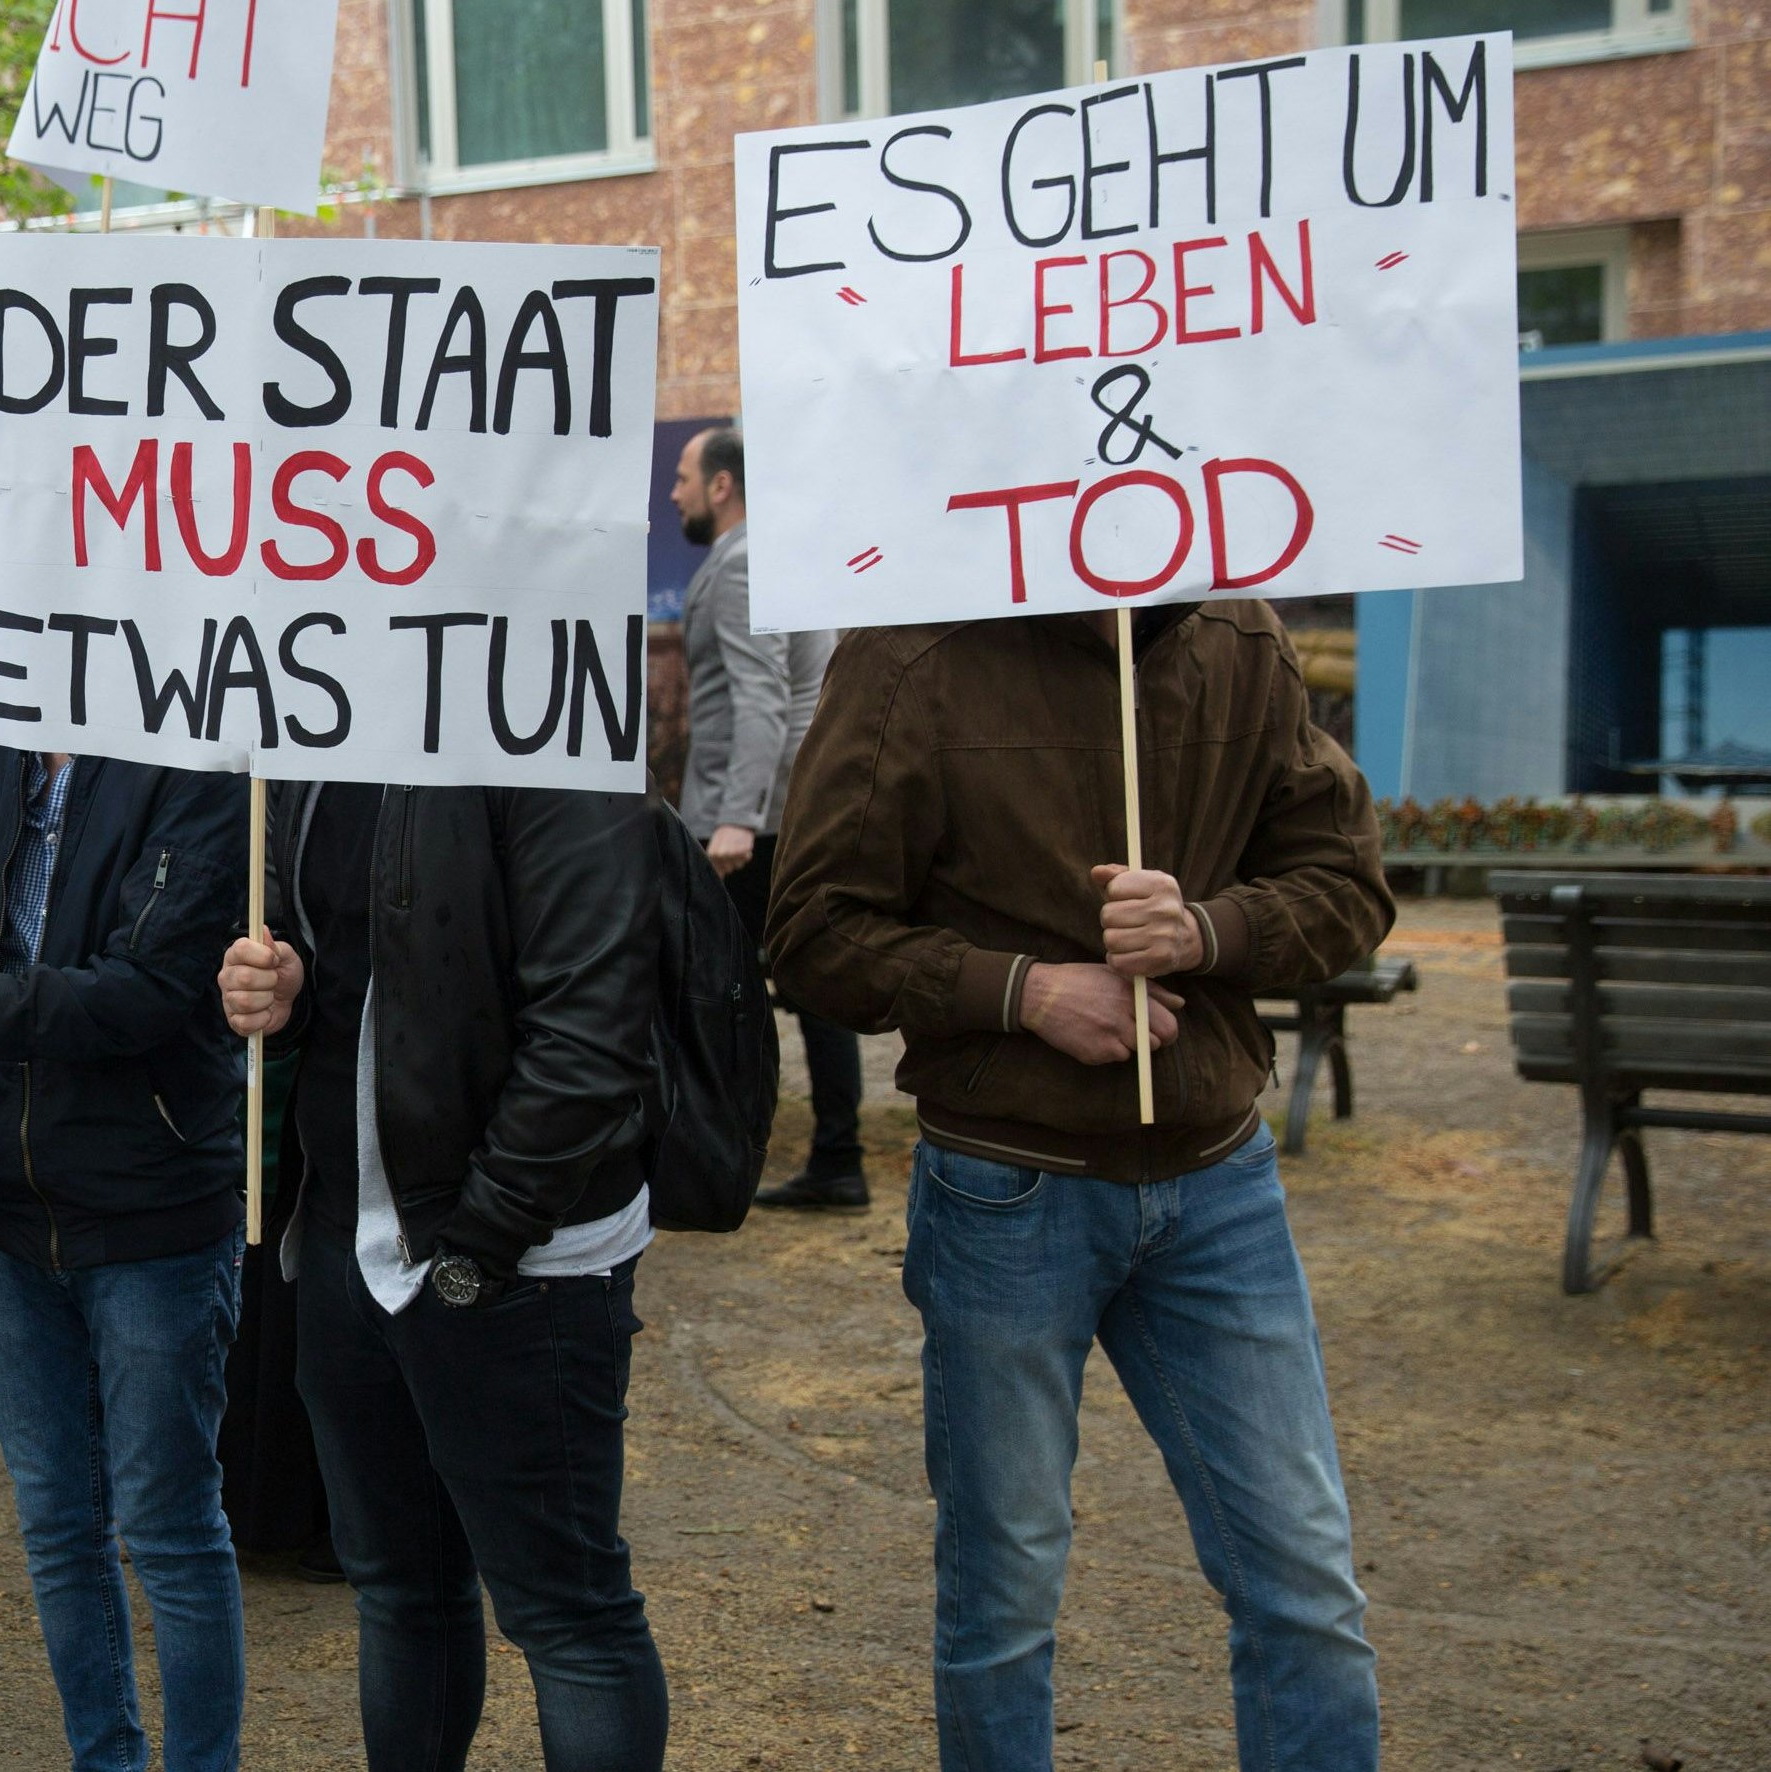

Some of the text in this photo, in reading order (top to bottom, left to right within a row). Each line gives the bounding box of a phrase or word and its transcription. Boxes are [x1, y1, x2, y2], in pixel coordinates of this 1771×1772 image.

[34, 63, 166, 162] WEG
[764, 40, 1489, 279] ES GEHT UM
[262, 275, 656, 438] STAAT
[1090, 363, 1184, 466] &
[72, 438, 437, 586] MUSS
[389, 612, 644, 762] TUN
